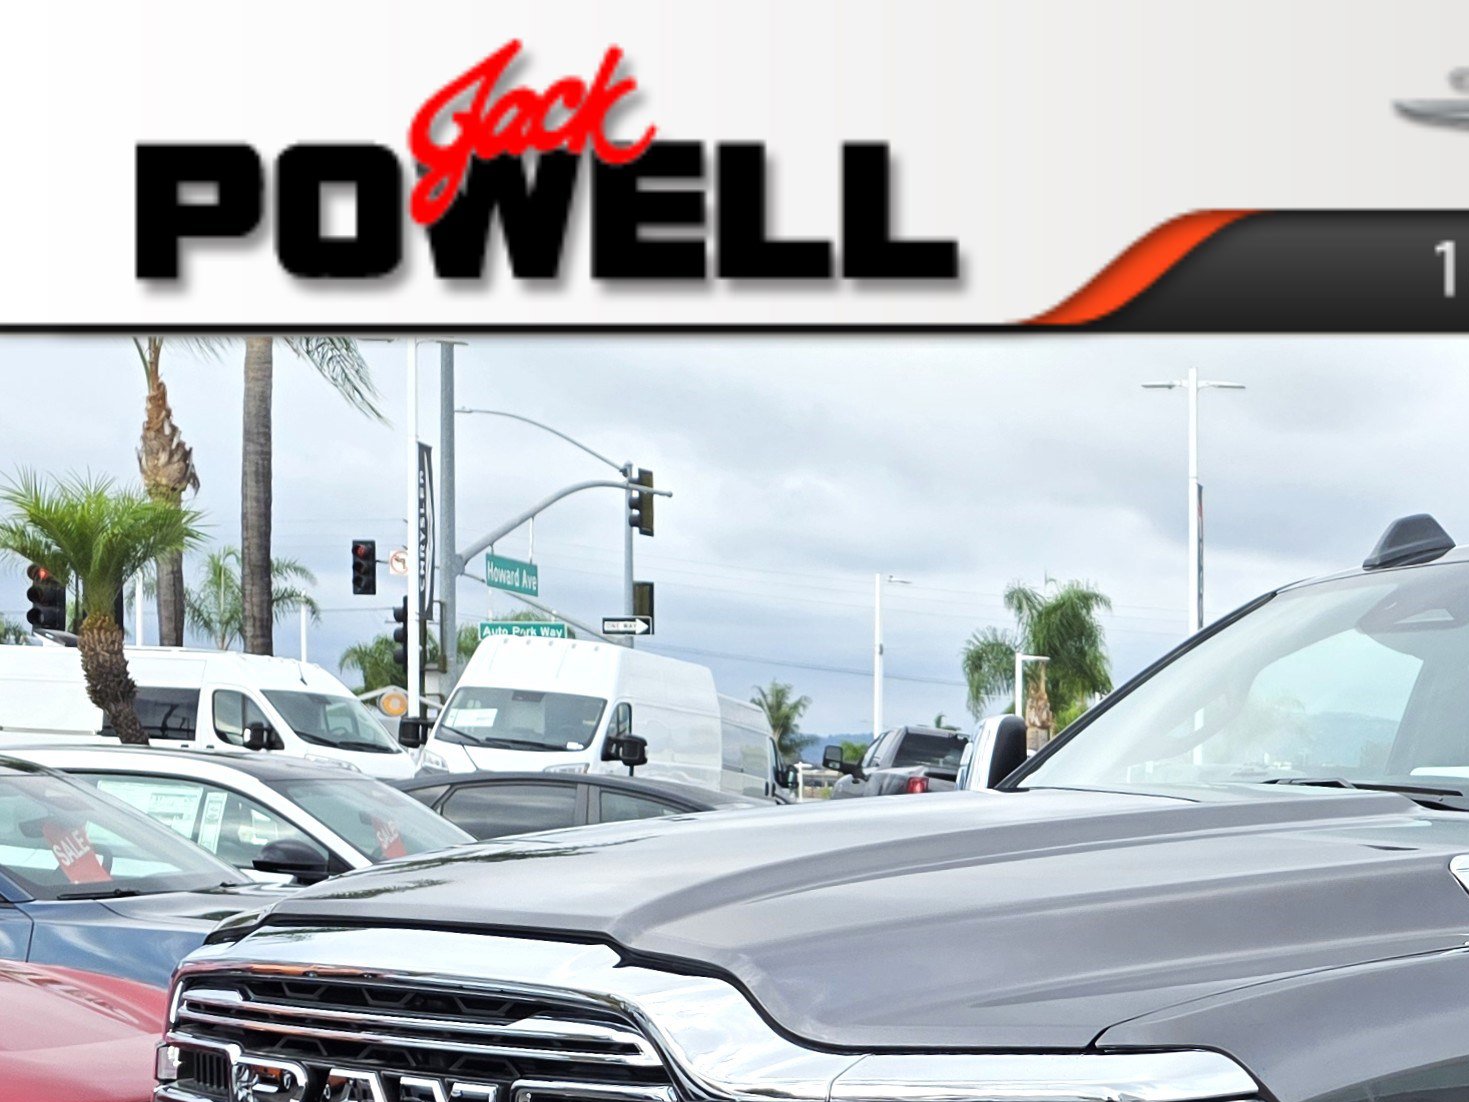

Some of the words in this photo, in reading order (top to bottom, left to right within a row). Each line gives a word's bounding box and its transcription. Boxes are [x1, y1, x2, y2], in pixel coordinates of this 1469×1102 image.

[487, 560, 520, 587] Howard
[521, 569, 538, 591] Ave
[482, 625, 509, 637] Auto
[539, 625, 564, 639] Way
[52, 829, 91, 866] SALE
